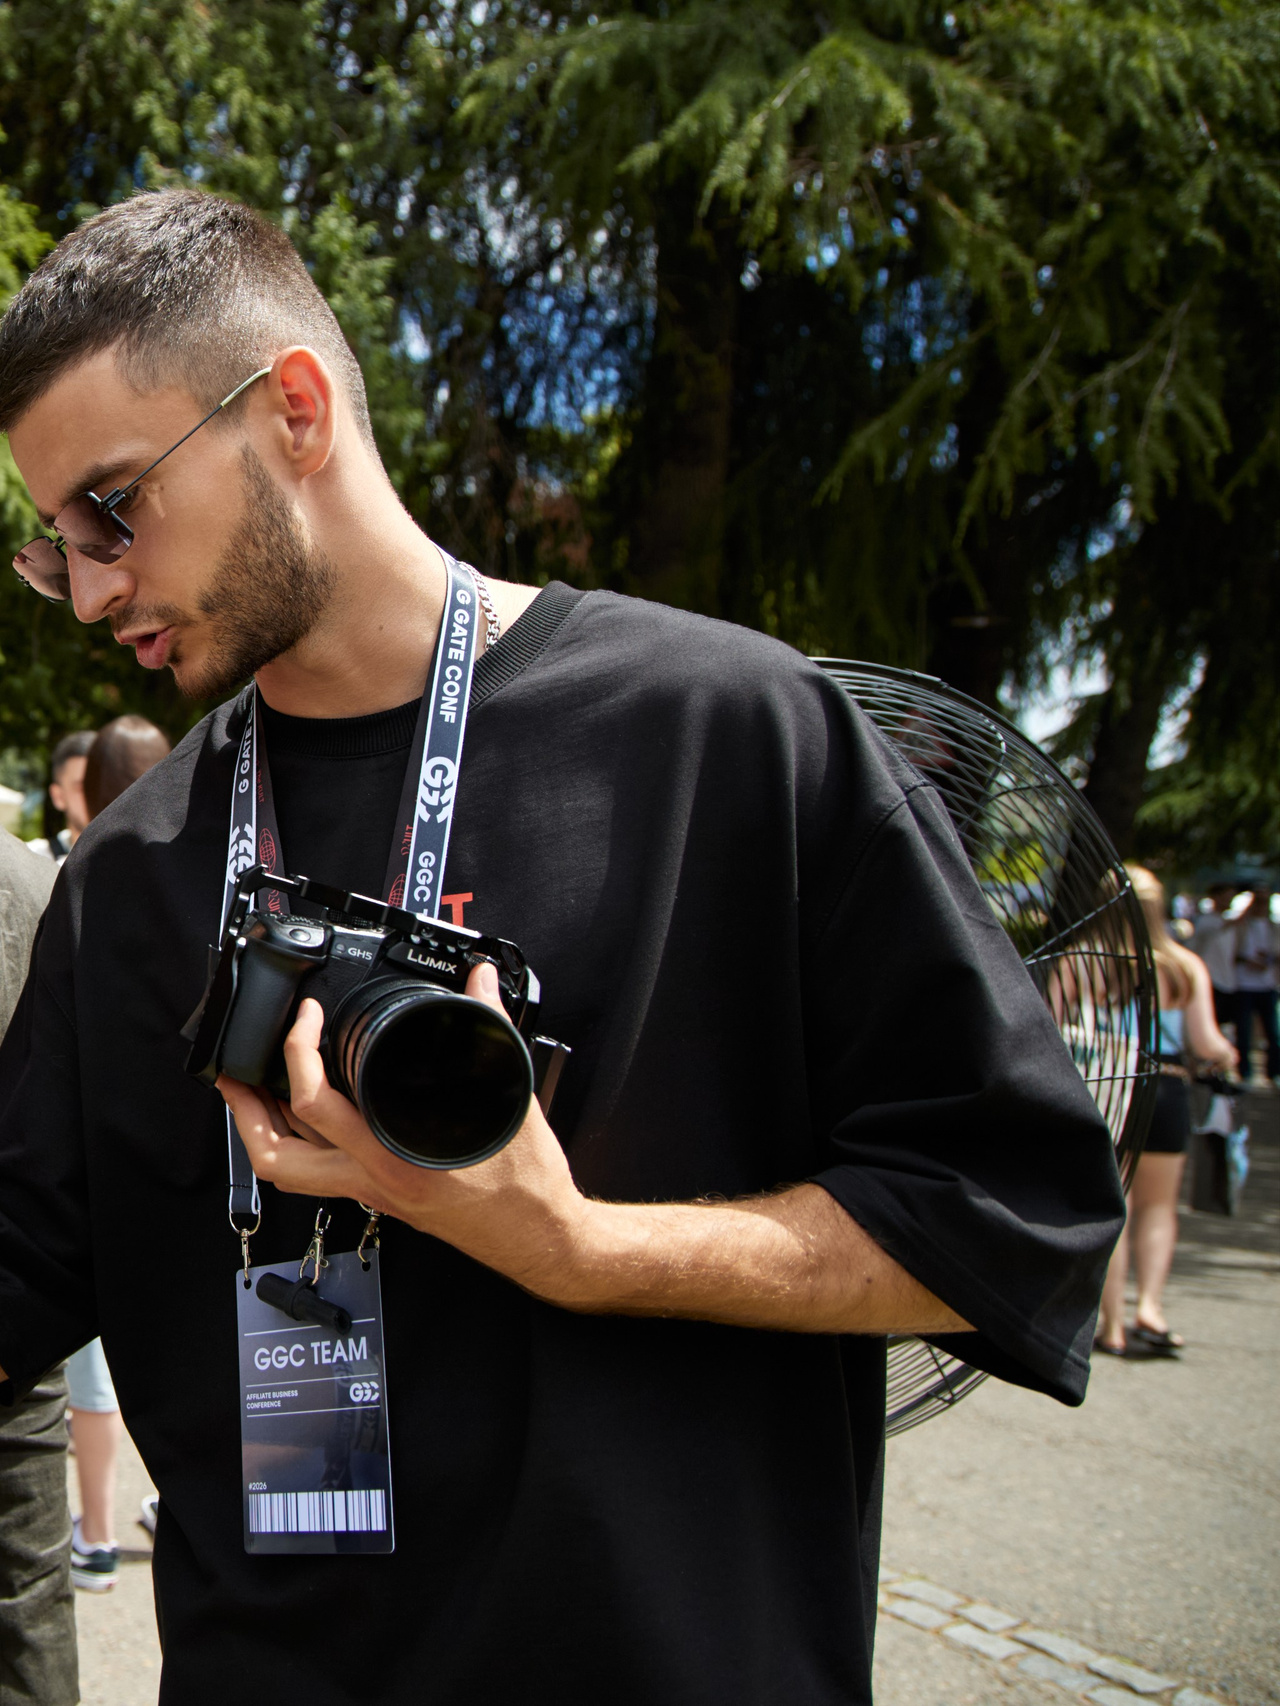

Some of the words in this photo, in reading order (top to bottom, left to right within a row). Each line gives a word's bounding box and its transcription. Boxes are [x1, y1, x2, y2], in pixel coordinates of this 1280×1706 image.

[456, 589, 471, 605] G
[448, 608, 470, 662] GATE
[439, 664, 462, 724] CONF
[242, 725, 252, 775] GATE
[238, 778, 250, 793] G
[414, 851, 436, 903] GGC
[347, 947, 373, 961] GH5
[406, 948, 458, 975] LUMIX
[254, 1343, 306, 1371] GGC
[310, 1336, 368, 1365] TEAM
[246, 1391, 271, 1400] AFFILIATE
[272, 1389, 299, 1399] BUSINESS
[246, 1400, 281, 1409] CONFERENCE
[248, 1482, 268, 1491] #2026
